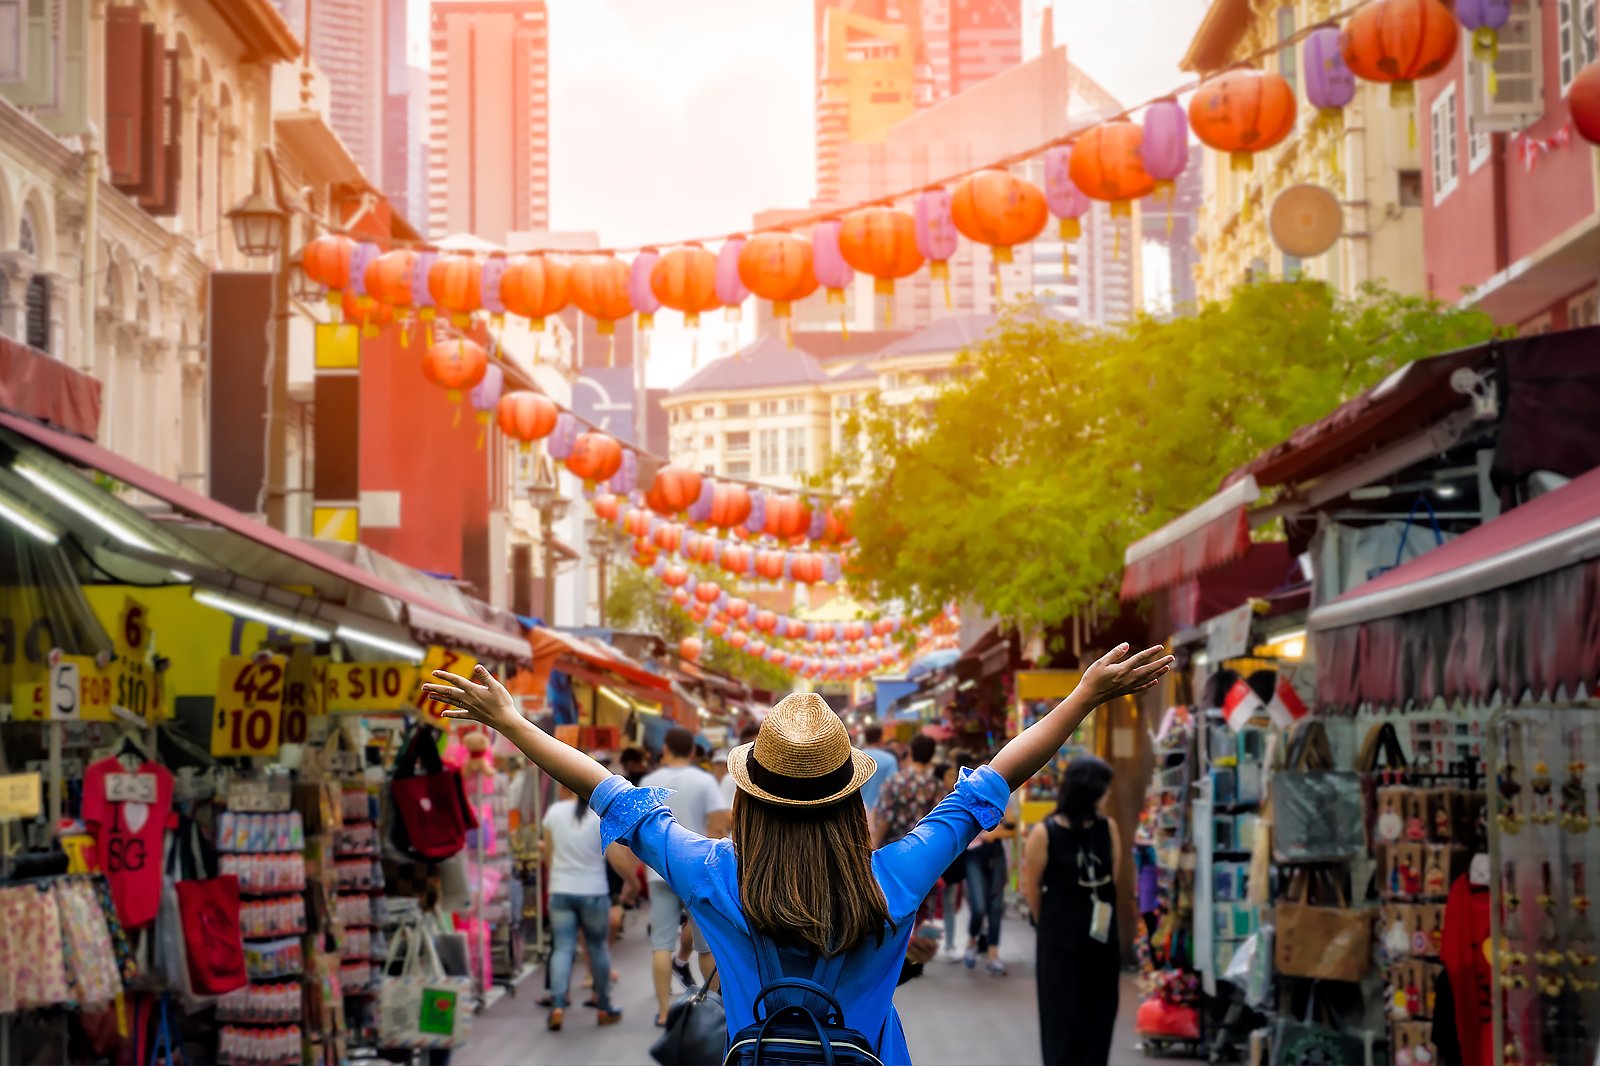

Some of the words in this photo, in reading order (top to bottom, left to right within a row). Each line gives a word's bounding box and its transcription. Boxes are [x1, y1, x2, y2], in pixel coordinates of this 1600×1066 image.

[125, 606, 143, 649] 6
[56, 665, 75, 713] 5
[81, 676, 111, 706] FOR
[118, 673, 147, 718] $10
[233, 663, 282, 703] 42
[347, 667, 401, 699] $10
[109, 838, 147, 873] SG
